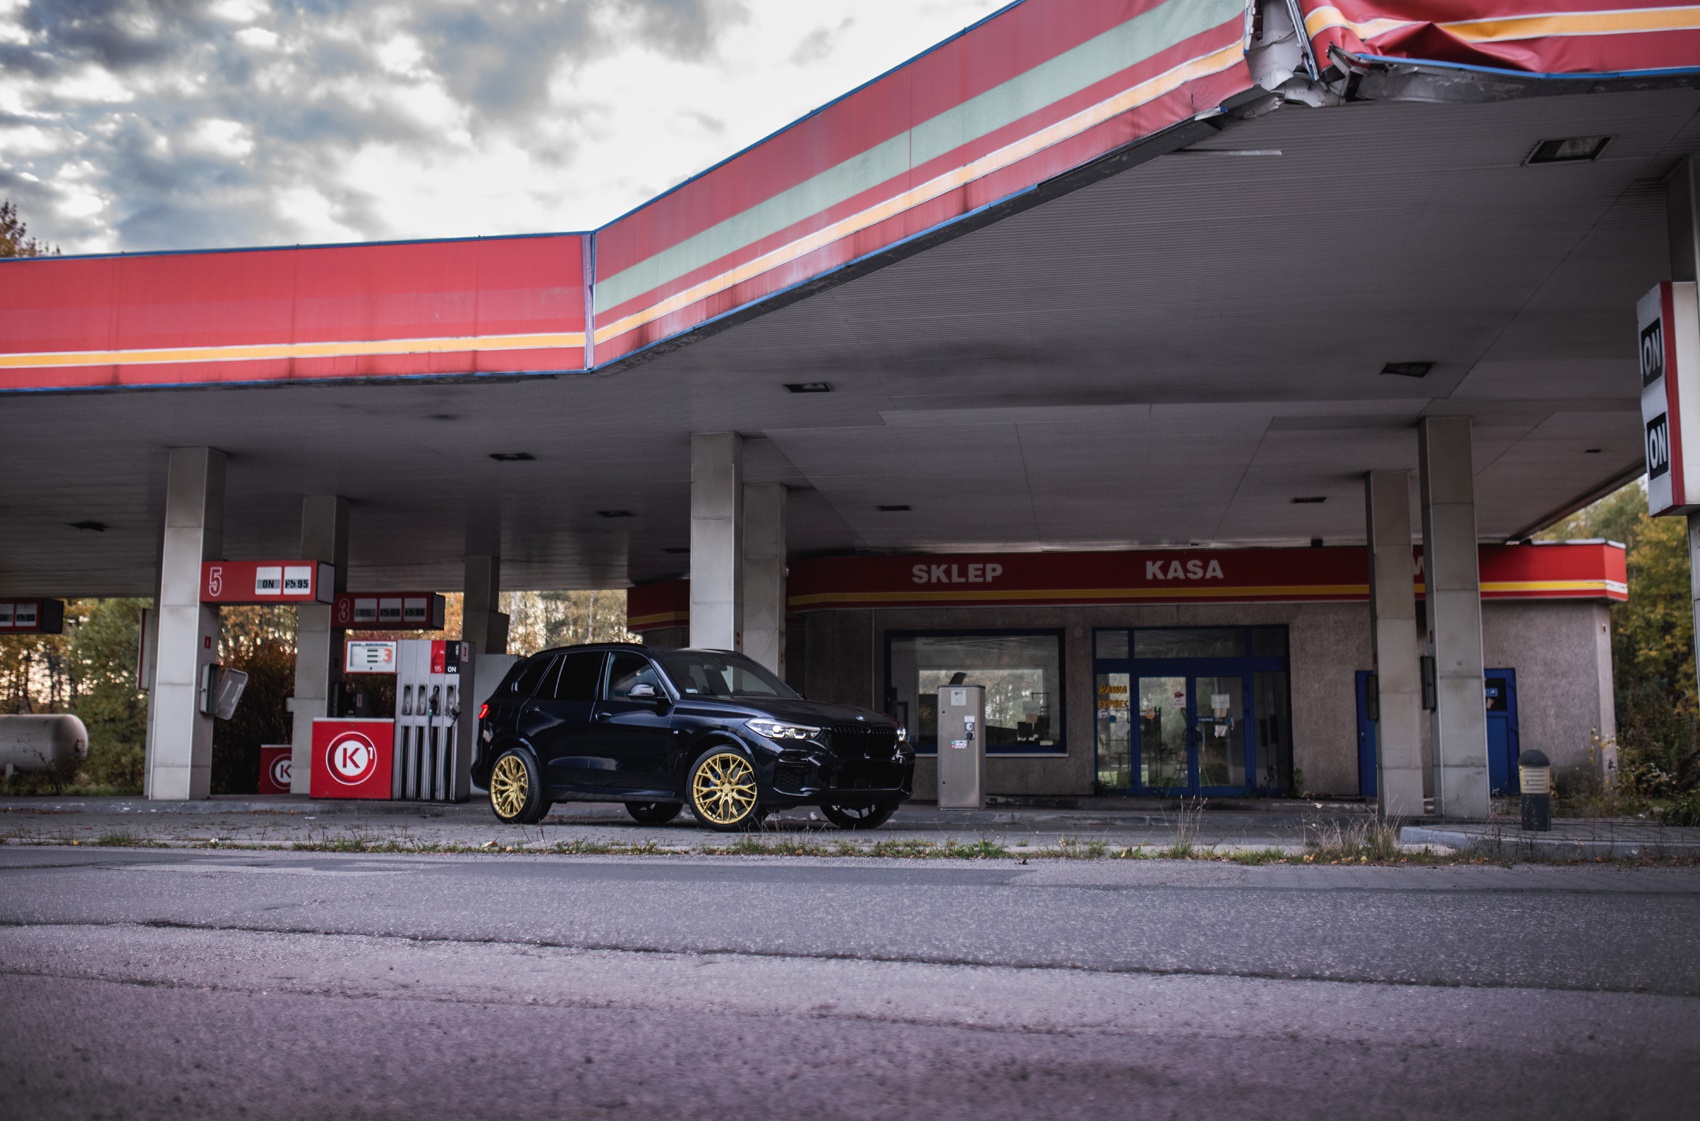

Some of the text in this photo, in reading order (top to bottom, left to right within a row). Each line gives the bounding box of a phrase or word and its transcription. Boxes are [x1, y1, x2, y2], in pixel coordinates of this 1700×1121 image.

[1643, 328, 1661, 377] ON
[1649, 422, 1667, 470] ON
[912, 562, 1003, 584] SKLEP
[1145, 559, 1224, 581] KASA
[208, 566, 222, 597] 5
[262, 579, 274, 588] ON
[338, 598, 350, 623] 3
[383, 648, 392, 663] 3
[434, 665, 442, 673] 95
[447, 665, 457, 673] ON
